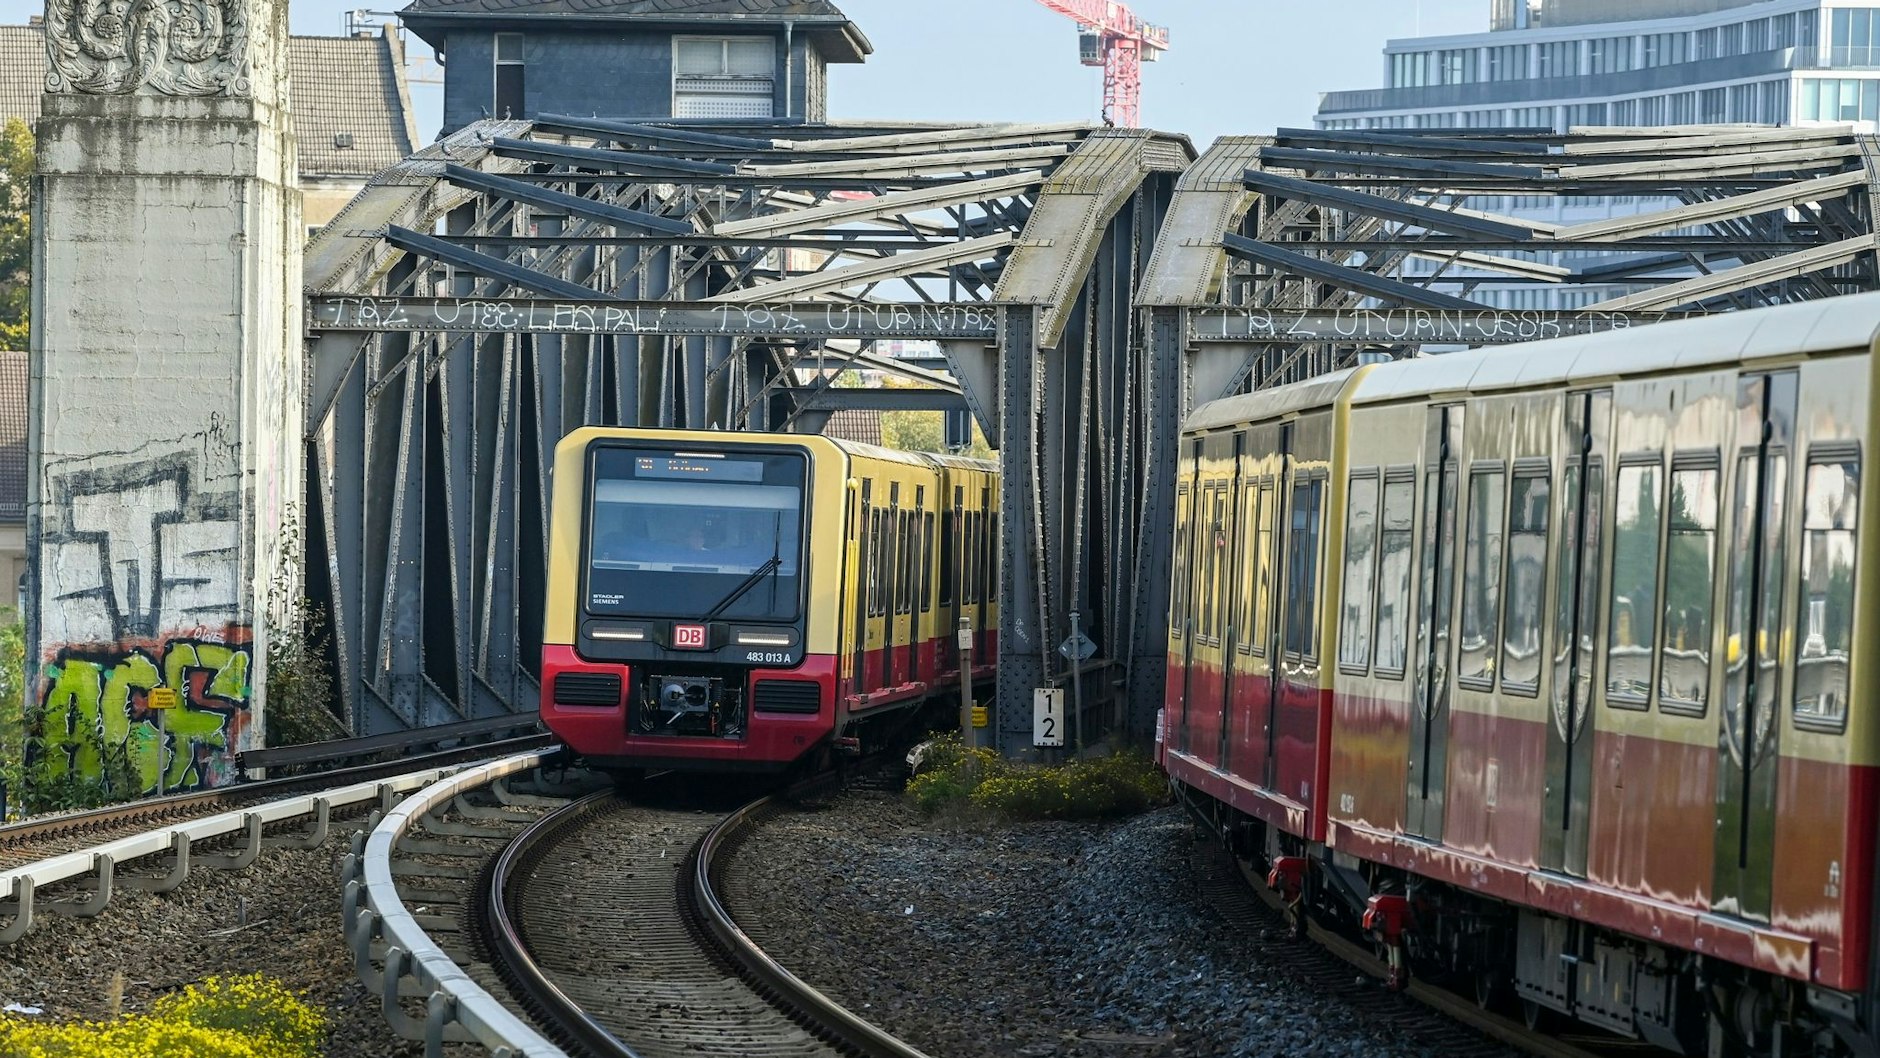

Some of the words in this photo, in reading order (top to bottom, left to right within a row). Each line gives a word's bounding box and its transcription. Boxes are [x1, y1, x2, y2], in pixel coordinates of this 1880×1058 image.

[680, 629, 701, 643] DB
[746, 651, 764, 662] 483
[765, 652, 782, 663] 013
[784, 654, 791, 663] A
[1045, 694, 1052, 714] 1
[1042, 717, 1055, 738] 2
